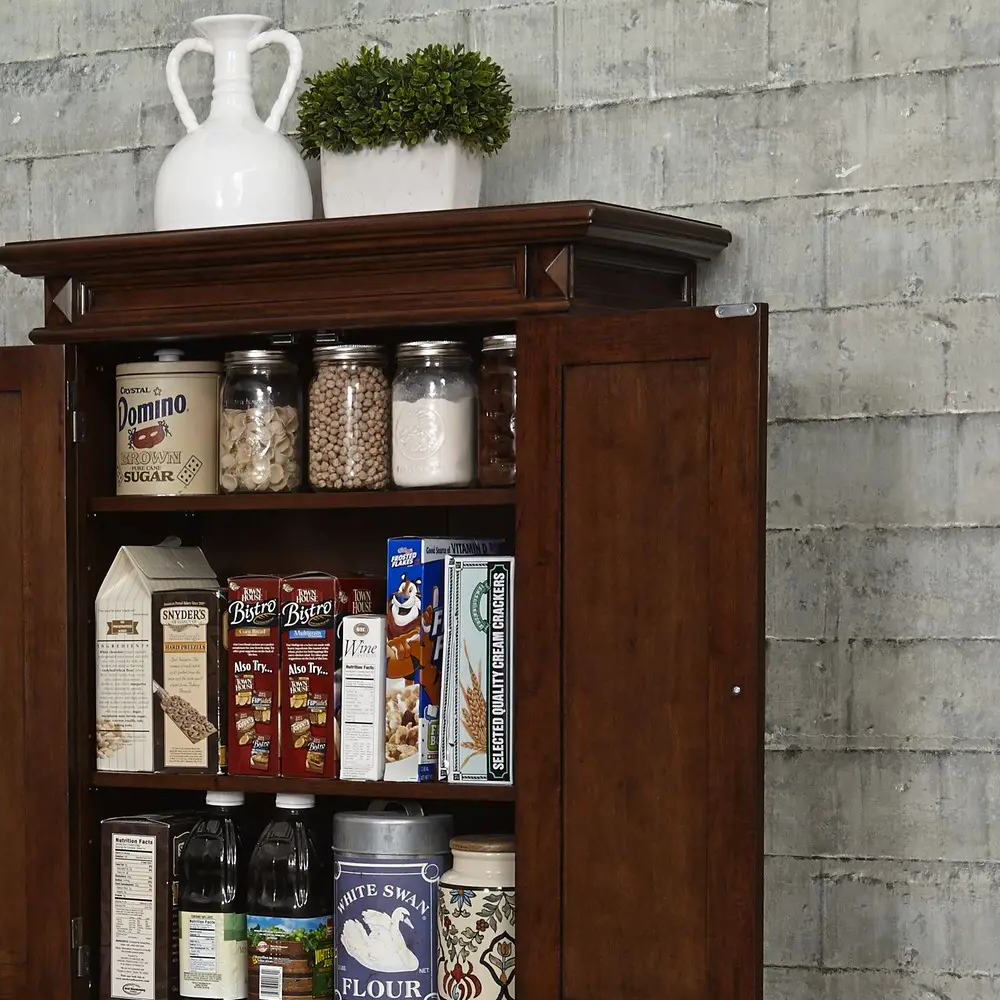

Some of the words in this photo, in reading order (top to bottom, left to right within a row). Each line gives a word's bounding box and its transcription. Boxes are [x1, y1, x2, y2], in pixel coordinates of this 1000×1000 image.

[120, 386, 151, 395] CRYSTAL
[118, 394, 187, 432] Domino
[120, 451, 182, 465] BROWN
[123, 471, 174, 483] SUGAR
[450, 543, 480, 554] VITAMIN
[391, 552, 417, 563] FROSTED
[352, 589, 371, 602] TOWN
[492, 572, 505, 630] CRACKERS
[162, 610, 206, 620] SNYDER'S
[228, 600, 277, 625] Bistro
[282, 601, 332, 627] Bistro
[352, 601, 372, 614] HOUSE
[344, 639, 378, 657] Wine
[492, 632, 505, 669] CREAM
[234, 661, 251, 673] Also
[252, 660, 272, 674] Try...
[288, 663, 306, 675] Also
[308, 662, 328, 675] Try...
[491, 671, 505, 715] QUALITY
[492, 716, 505, 770] SELECTED
[337, 884, 378, 914] WHITE
[382, 885, 430, 915] SWAN
[342, 977, 422, 999] FLOUR
